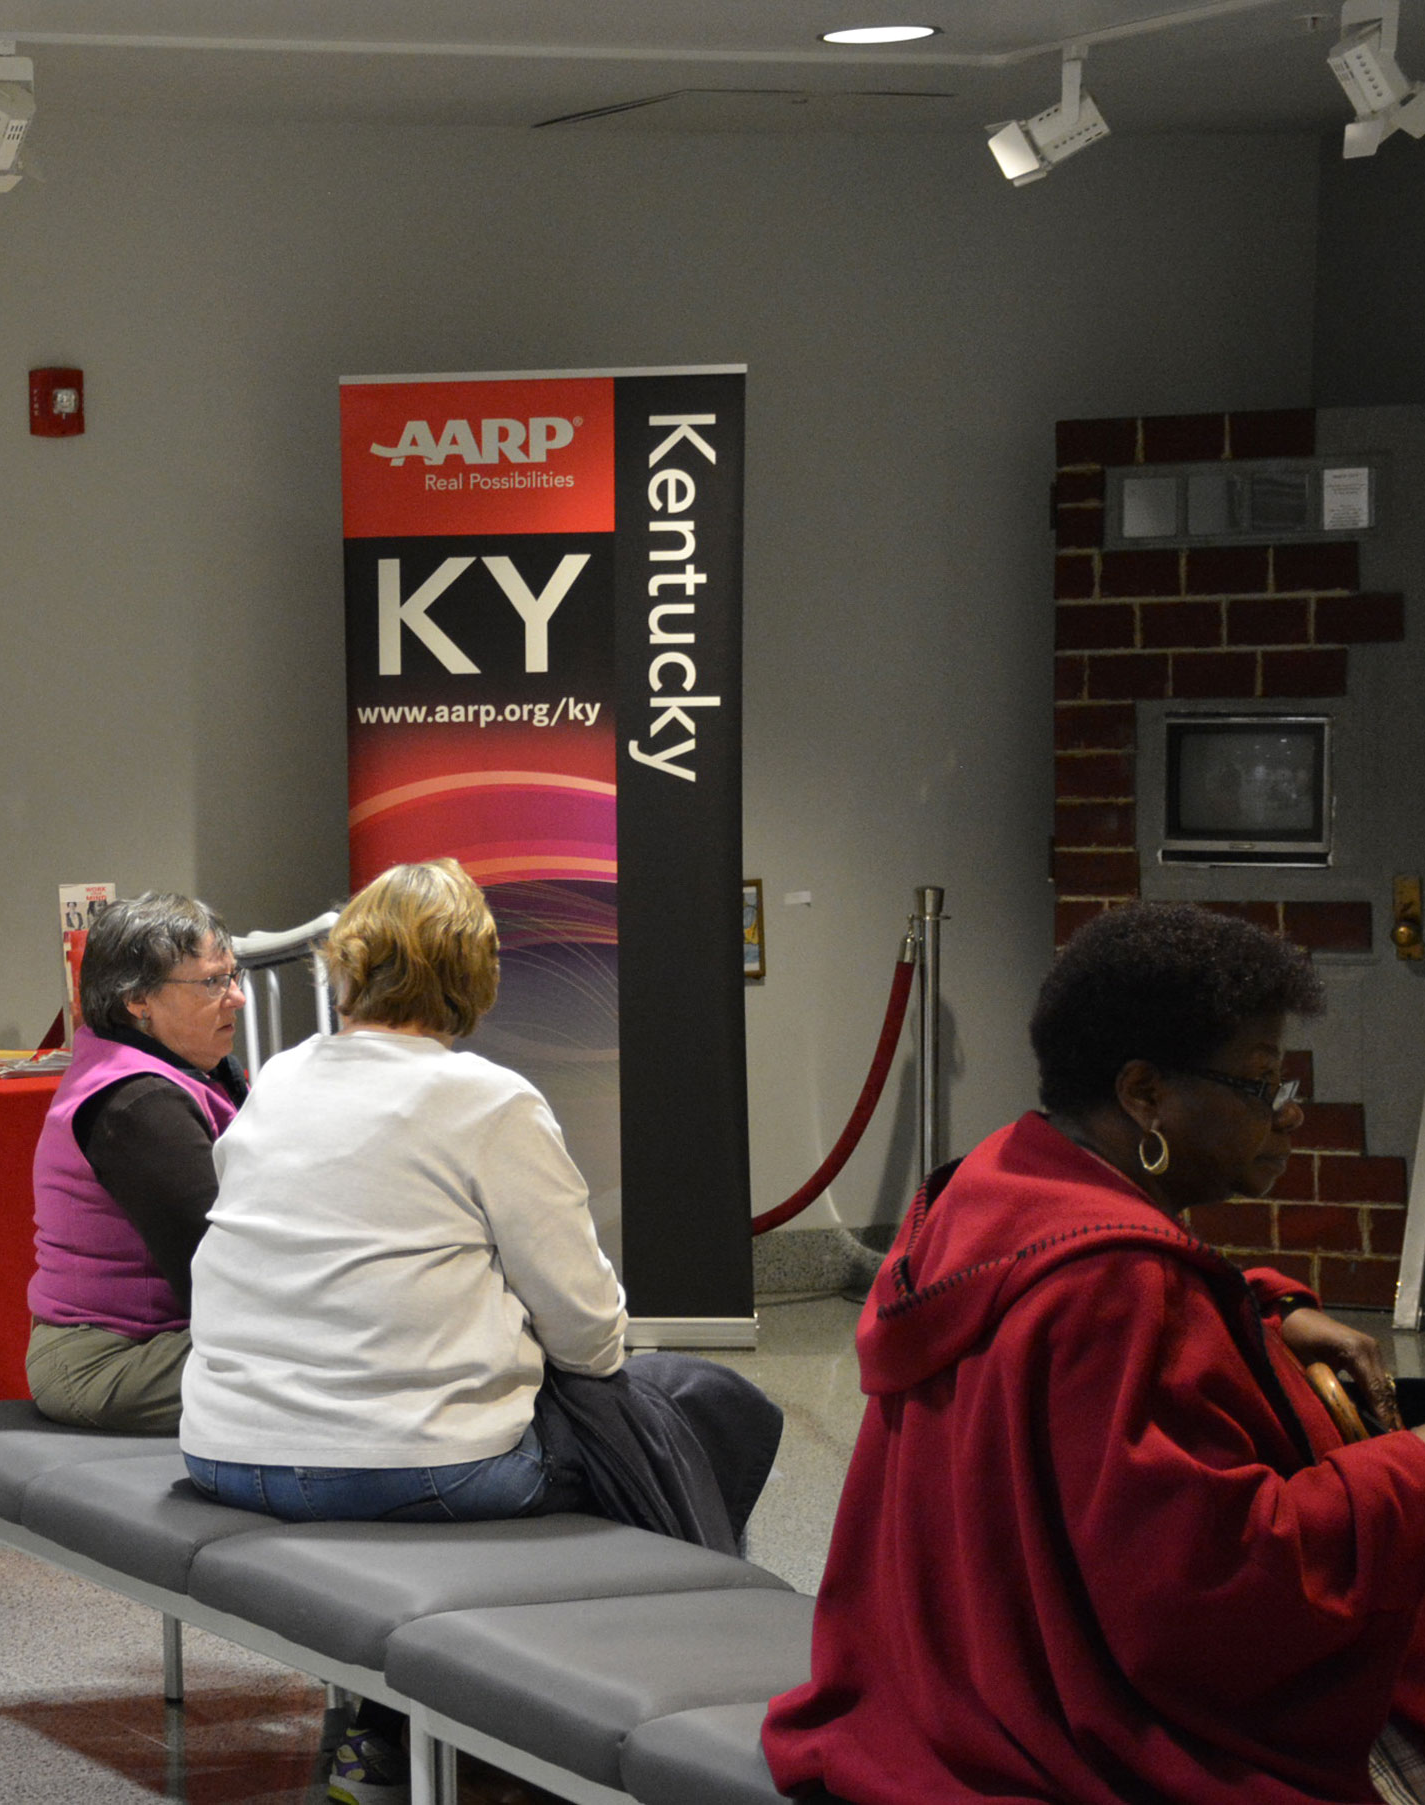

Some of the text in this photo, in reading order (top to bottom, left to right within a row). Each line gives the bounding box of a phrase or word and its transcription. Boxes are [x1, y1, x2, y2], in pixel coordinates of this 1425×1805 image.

[425, 471, 575, 491] Real Possibilities
[377, 553, 592, 676] KY
[628, 413, 721, 782] Kentucky
[357, 697, 601, 728] www.aarp.org/ky
